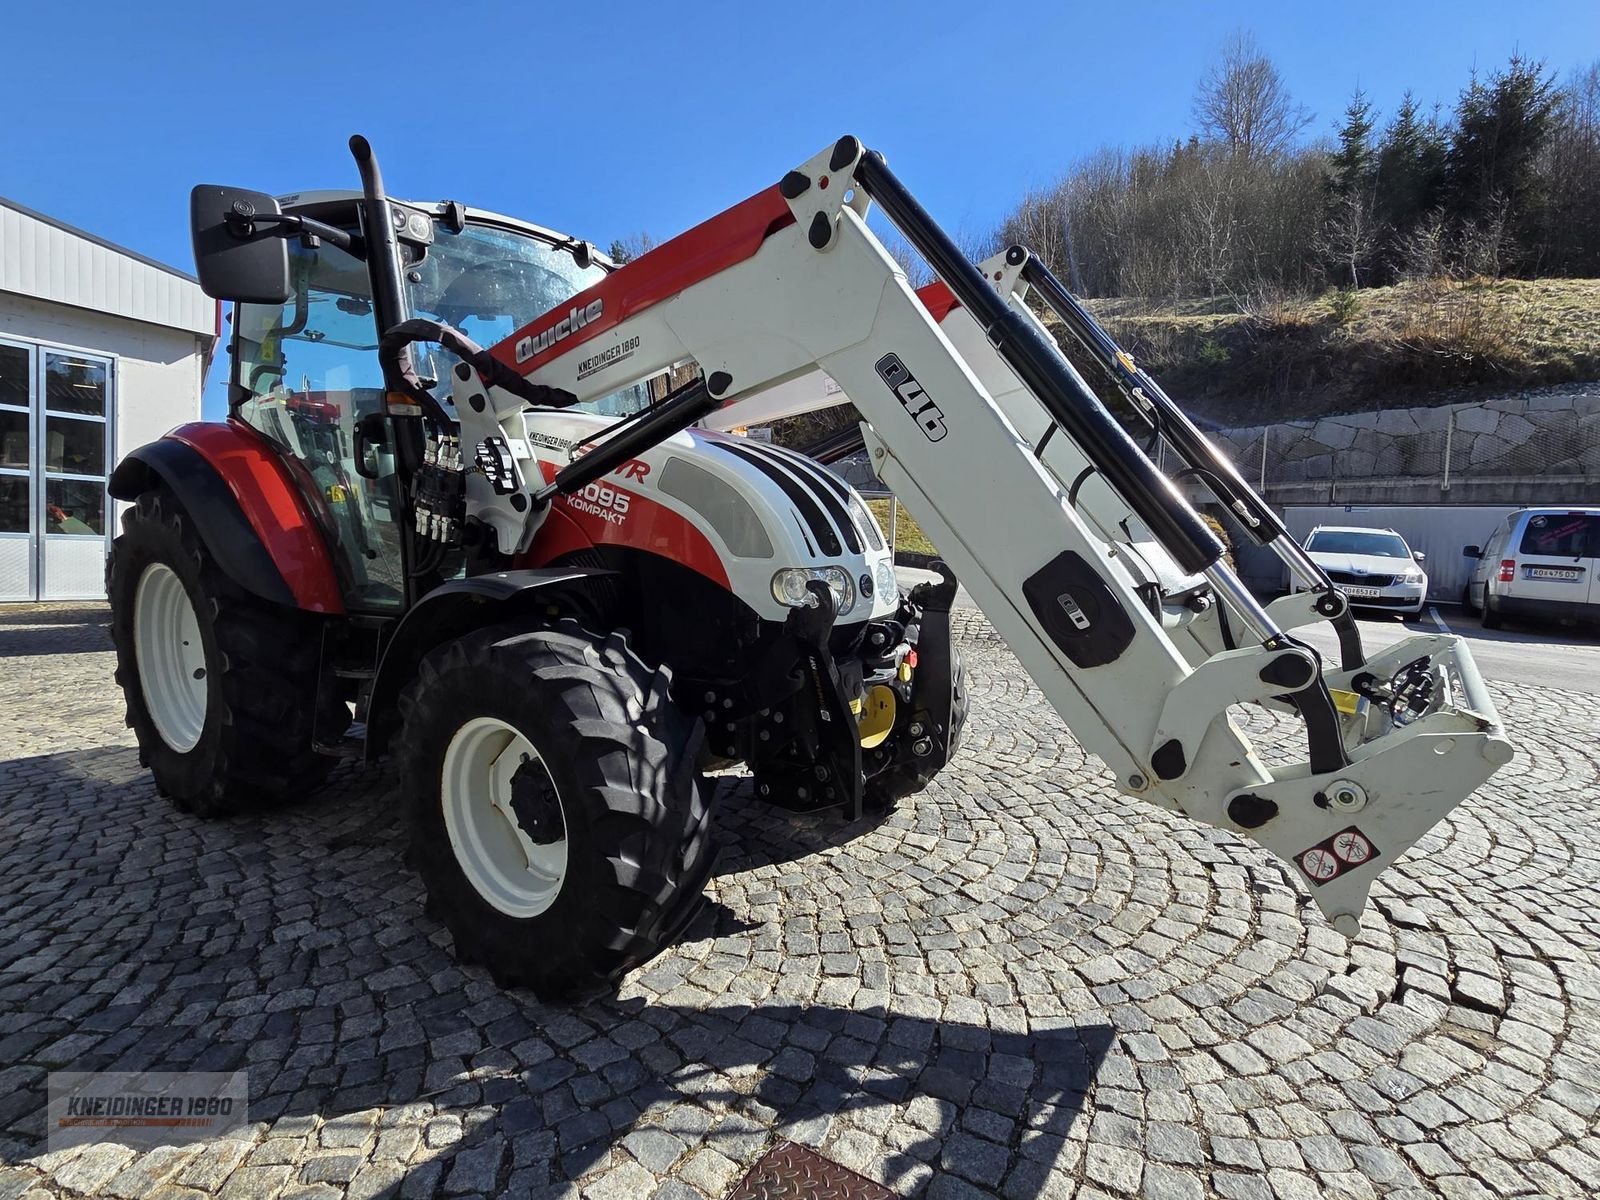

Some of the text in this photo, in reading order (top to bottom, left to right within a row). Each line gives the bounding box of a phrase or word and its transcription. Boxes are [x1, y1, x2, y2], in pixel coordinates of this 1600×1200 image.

[515, 297, 603, 364] Quicke
[578, 345, 621, 374] KNEIDINGER
[621, 335, 640, 354] 1880
[875, 352, 948, 442] Q46
[567, 496, 626, 526] KOMPAKT
